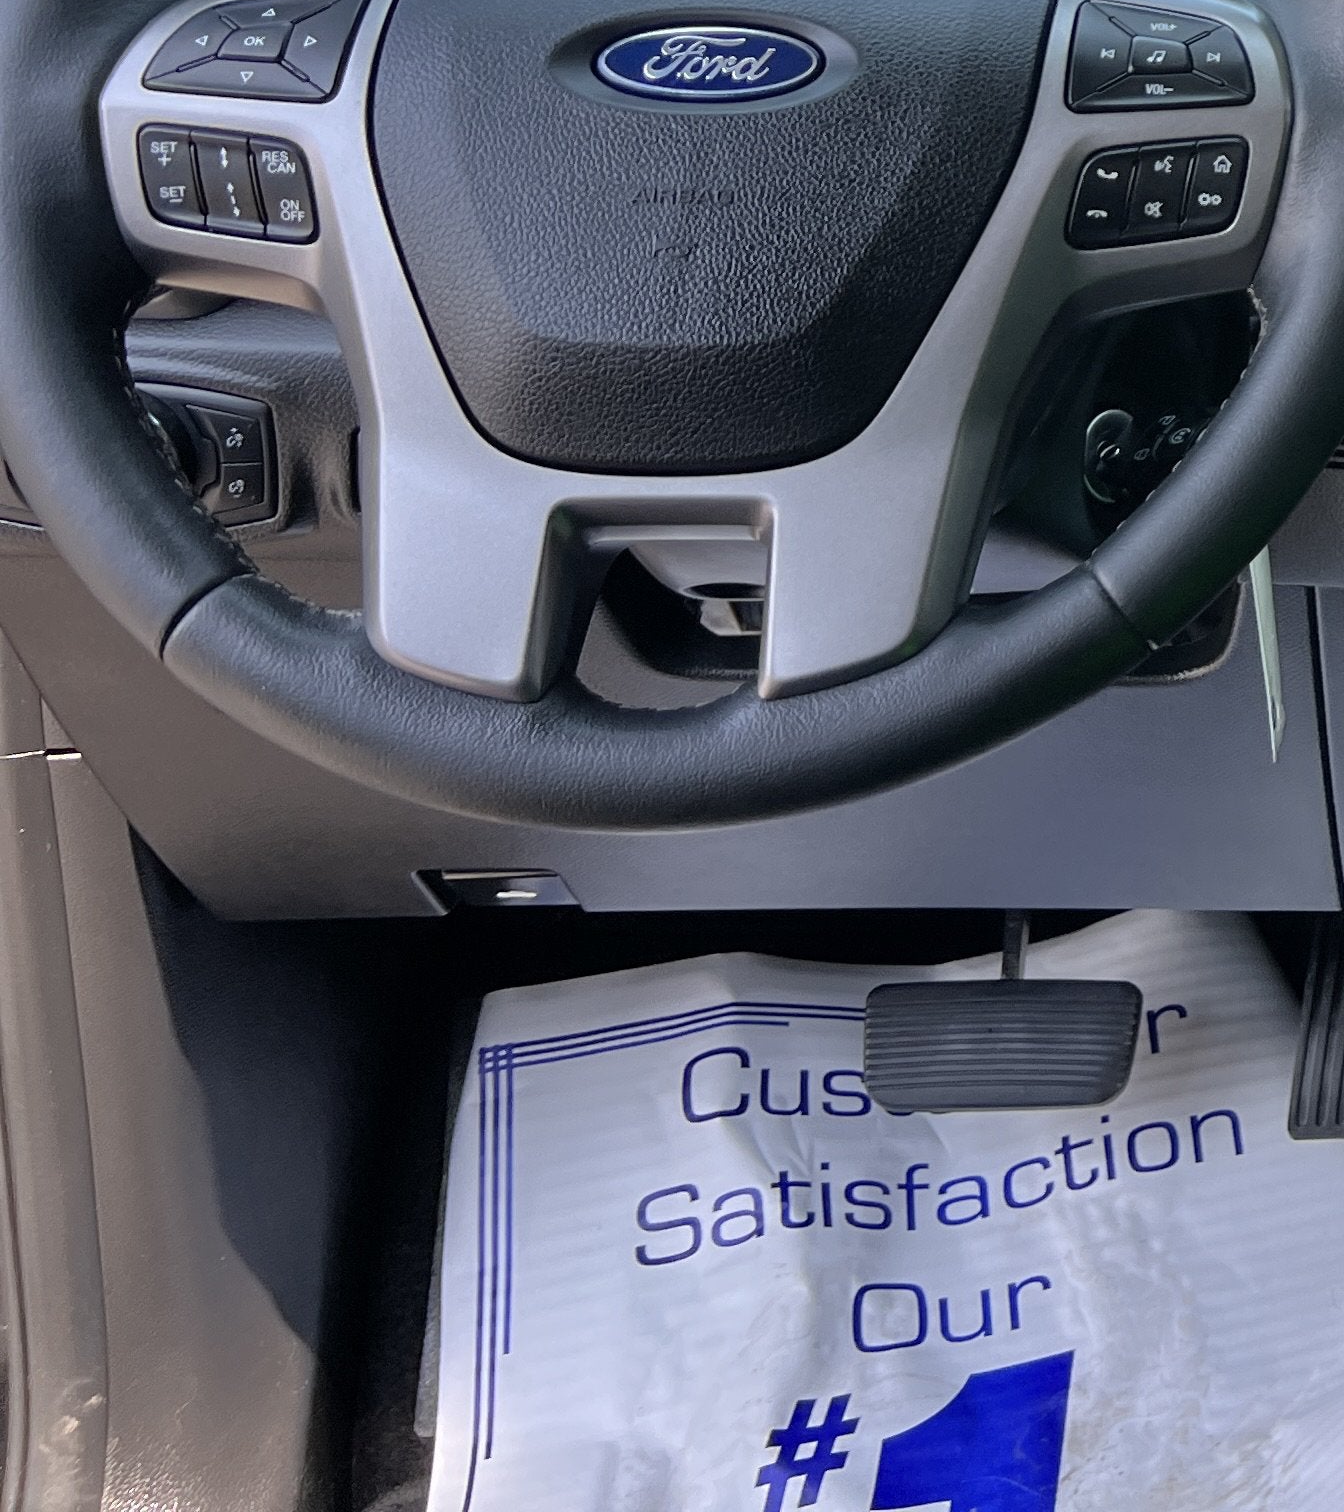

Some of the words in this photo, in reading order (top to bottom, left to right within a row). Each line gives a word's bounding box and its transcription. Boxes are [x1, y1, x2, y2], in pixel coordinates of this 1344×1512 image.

[243, 36, 266, 46] OK
[643, 34, 777, 82] Ford
[150, 141, 178, 154] SET
[261, 150, 289, 163] RES
[267, 162, 296, 174] CAN
[159, 186, 186, 199] SET
[280, 199, 300, 210] ON
[280, 210, 305, 222] OFF
[682, 1003, 1188, 1124] Cusr
[634, 1105, 1246, 1267] Satisfaction
[852, 1273, 1053, 1353] Our
